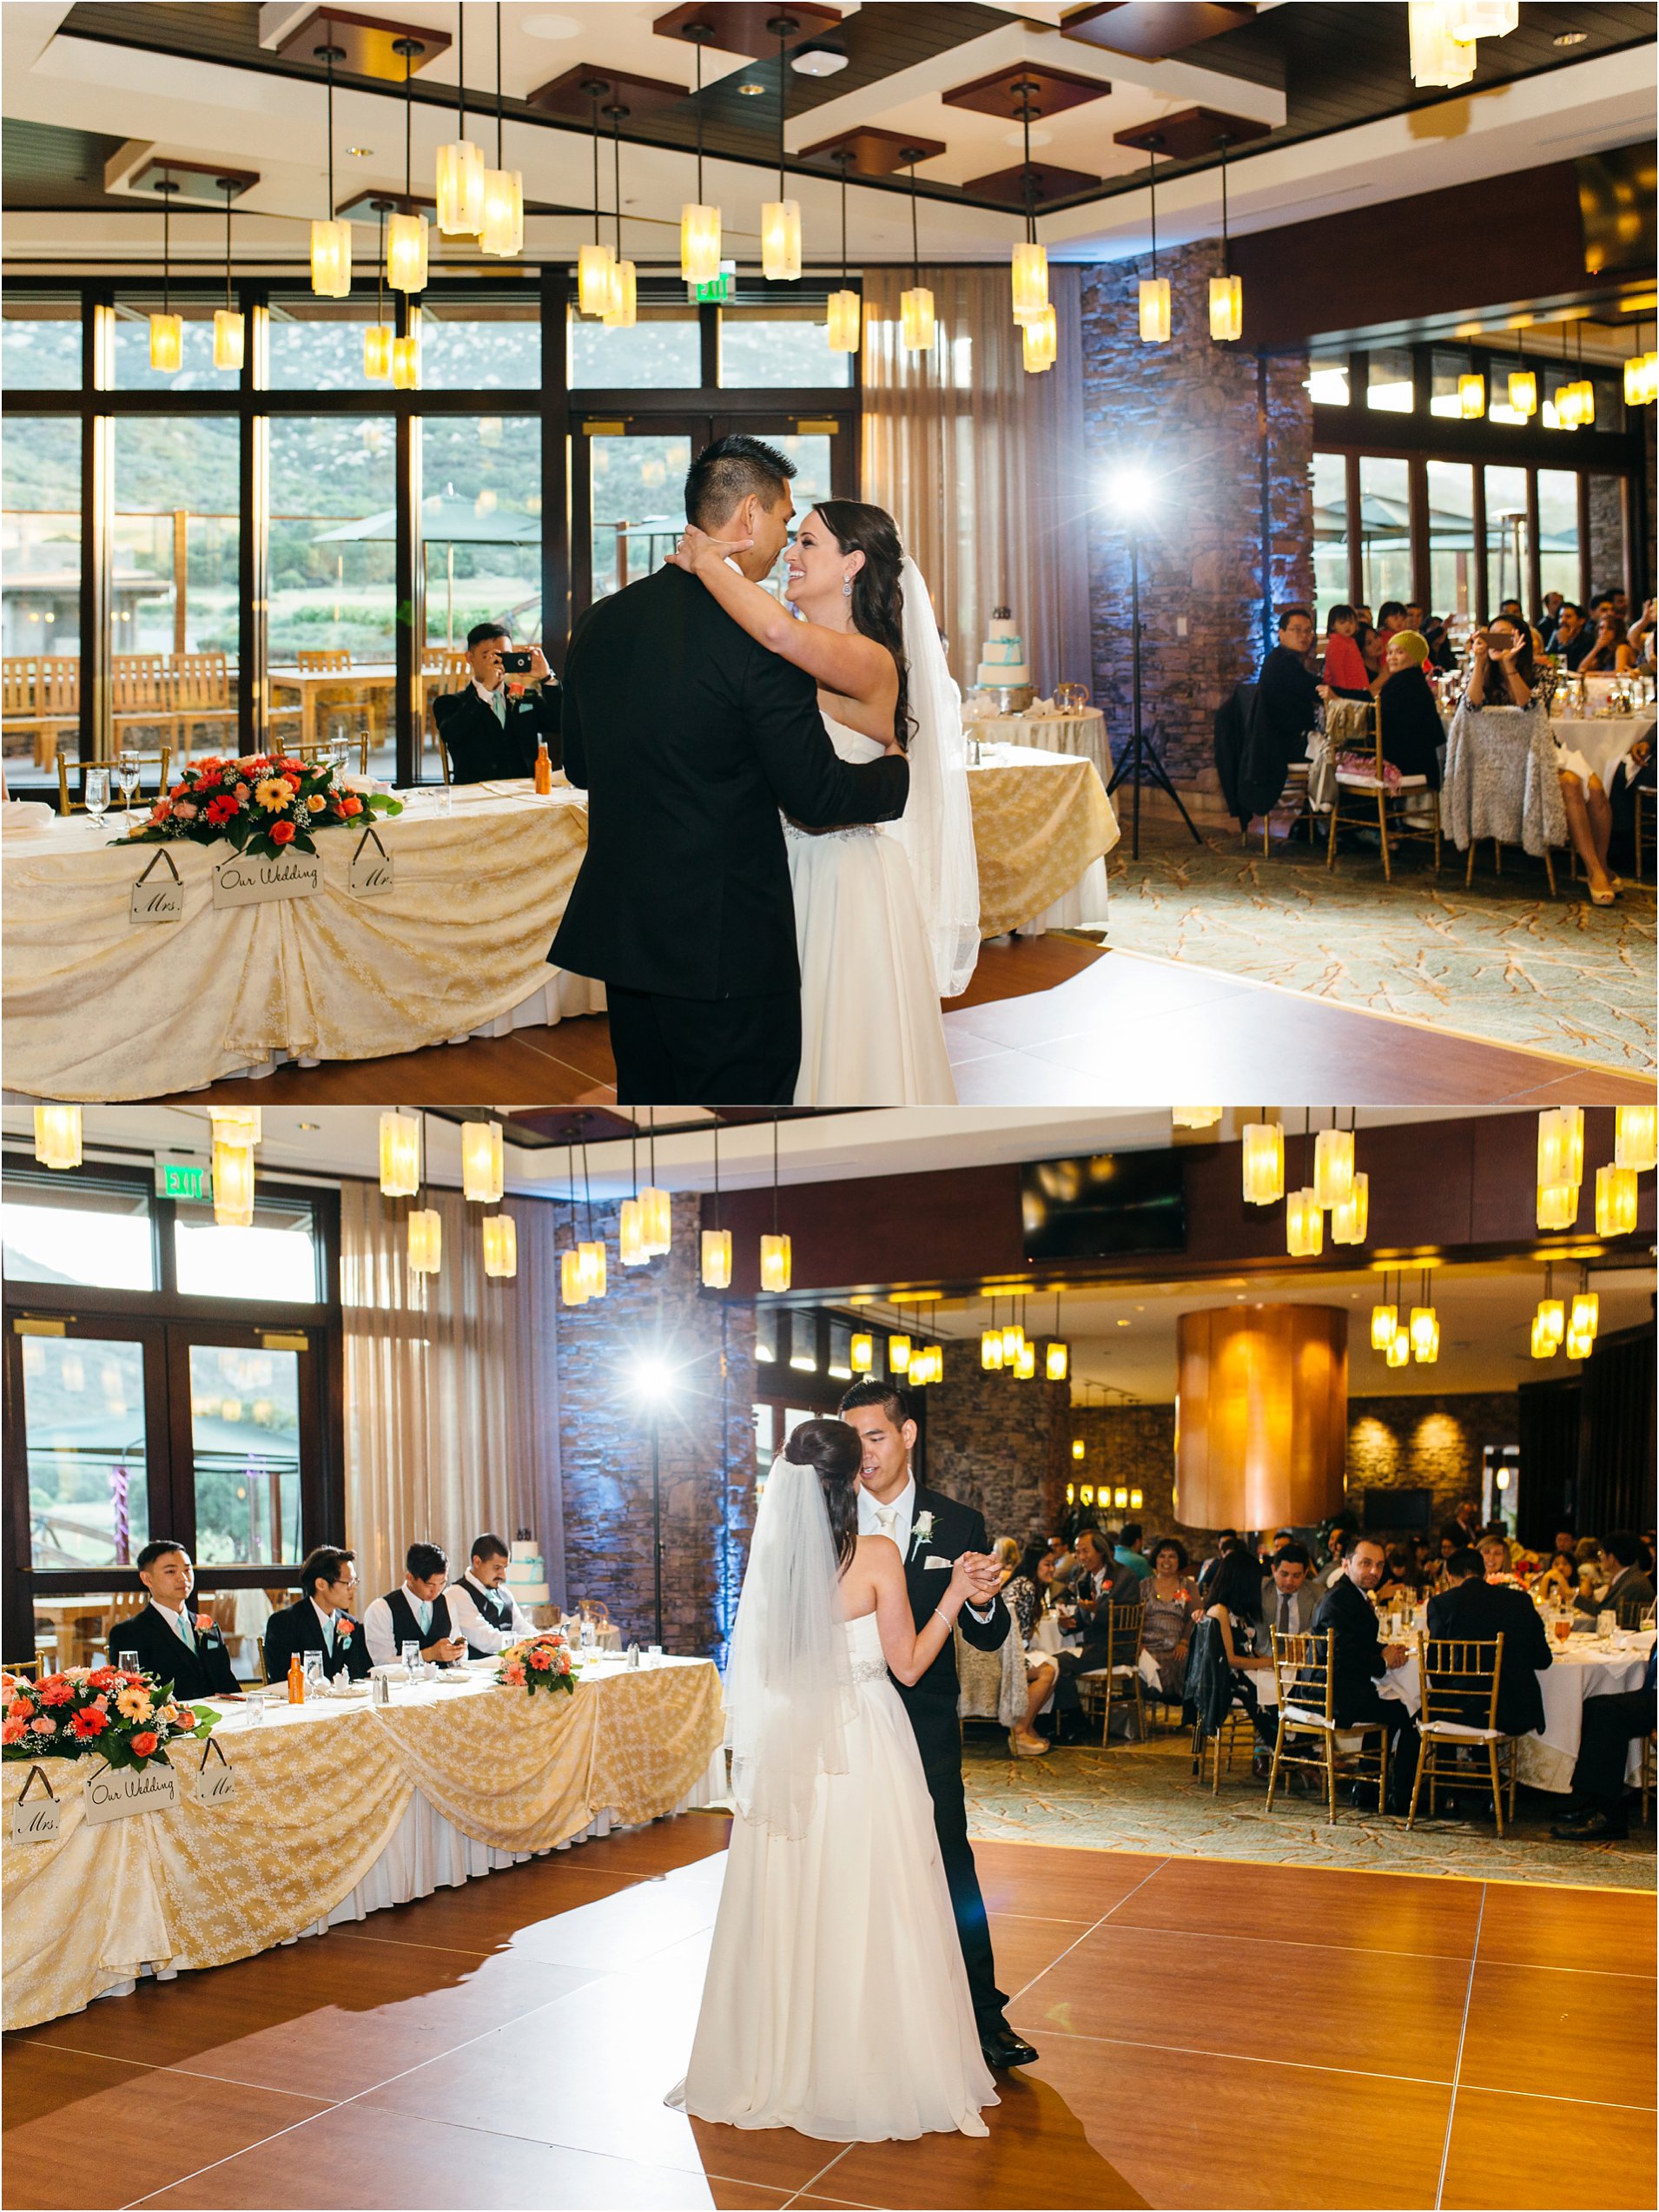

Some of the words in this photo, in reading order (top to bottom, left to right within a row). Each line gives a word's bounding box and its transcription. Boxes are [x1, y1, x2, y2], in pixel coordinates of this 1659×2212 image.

[221, 870, 255, 889] Our
[261, 865, 318, 888] Wedding
[352, 868, 393, 888] Mr.
[134, 893, 181, 913] Mrs.
[164, 1165, 203, 1198] EXIT
[92, 1785, 122, 1805] Our
[124, 1777, 175, 1799] Wedding
[202, 1777, 235, 1799] Mr.
[18, 1811, 59, 1833] Mrs.
